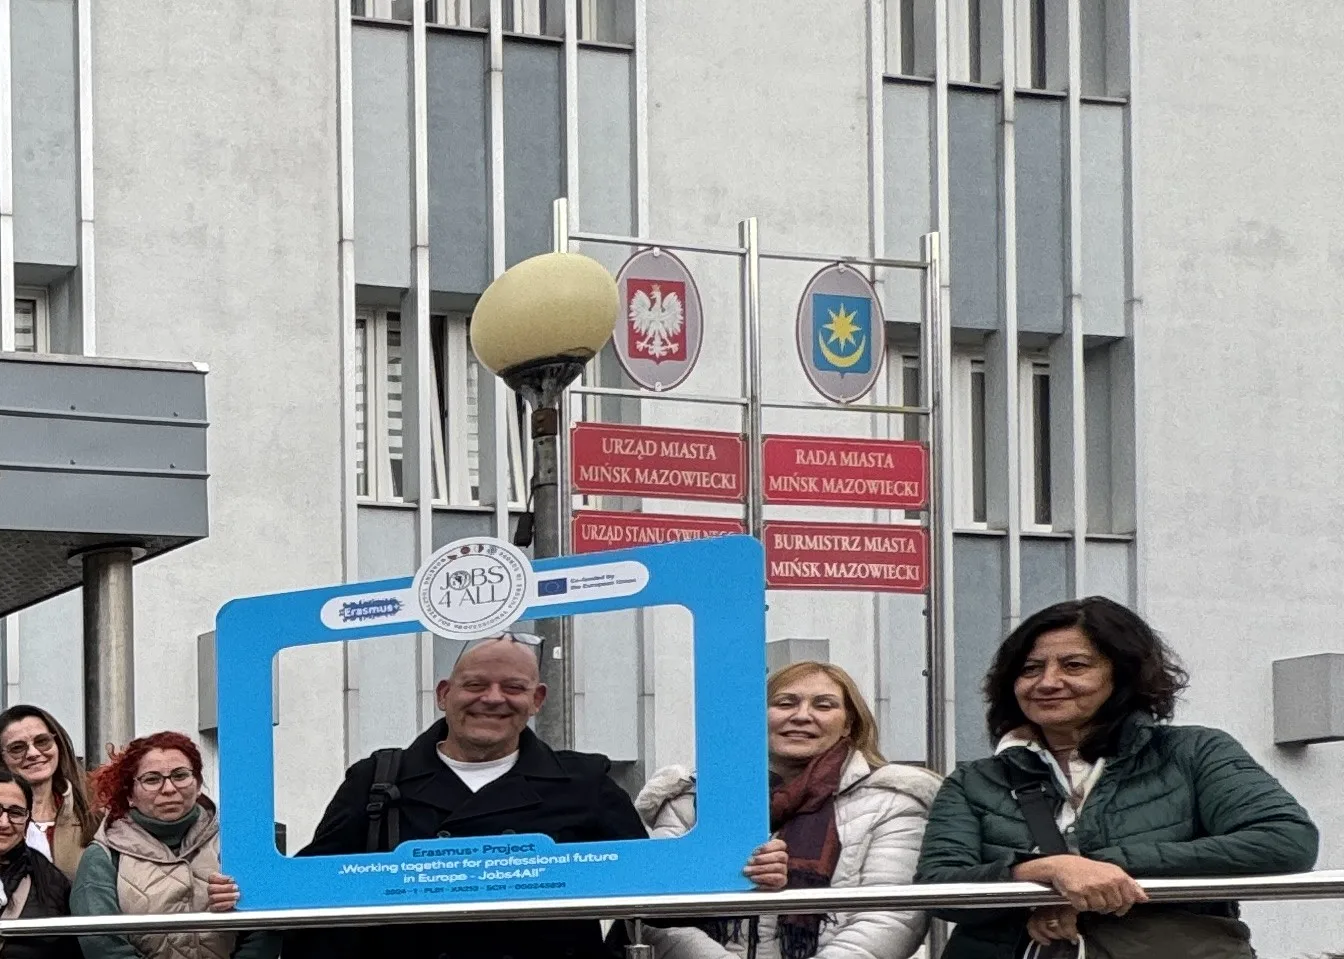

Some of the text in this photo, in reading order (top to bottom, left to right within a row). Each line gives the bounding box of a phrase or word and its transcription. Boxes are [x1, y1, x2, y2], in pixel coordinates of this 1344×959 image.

[602, 438, 716, 460] URZĄD MIASTA
[796, 449, 894, 469] RADA MIASTA
[579, 463, 736, 489] MIŃSK MAZOWIECKI
[769, 472, 919, 497] MIŃSK MAZOWIECKI
[581, 524, 737, 545] URZĄD STANU CYWIL
[774, 533, 917, 554] BURMISTRZ MIASTA
[440, 565, 504, 590] JOBS
[771, 557, 920, 581] MIŃSK MAZOWIECKI
[438, 590, 452, 608] 4
[459, 585, 508, 607] ALL
[344, 603, 399, 617] Erasmus+
[412, 843, 536, 858] Erasmus+ Project
[401, 859, 460, 872] together
[463, 858, 482, 868] for
[485, 853, 570, 869] professional
[573, 852, 619, 863] future
[403, 874, 415, 884] in
[418, 873, 468, 884] Europe
